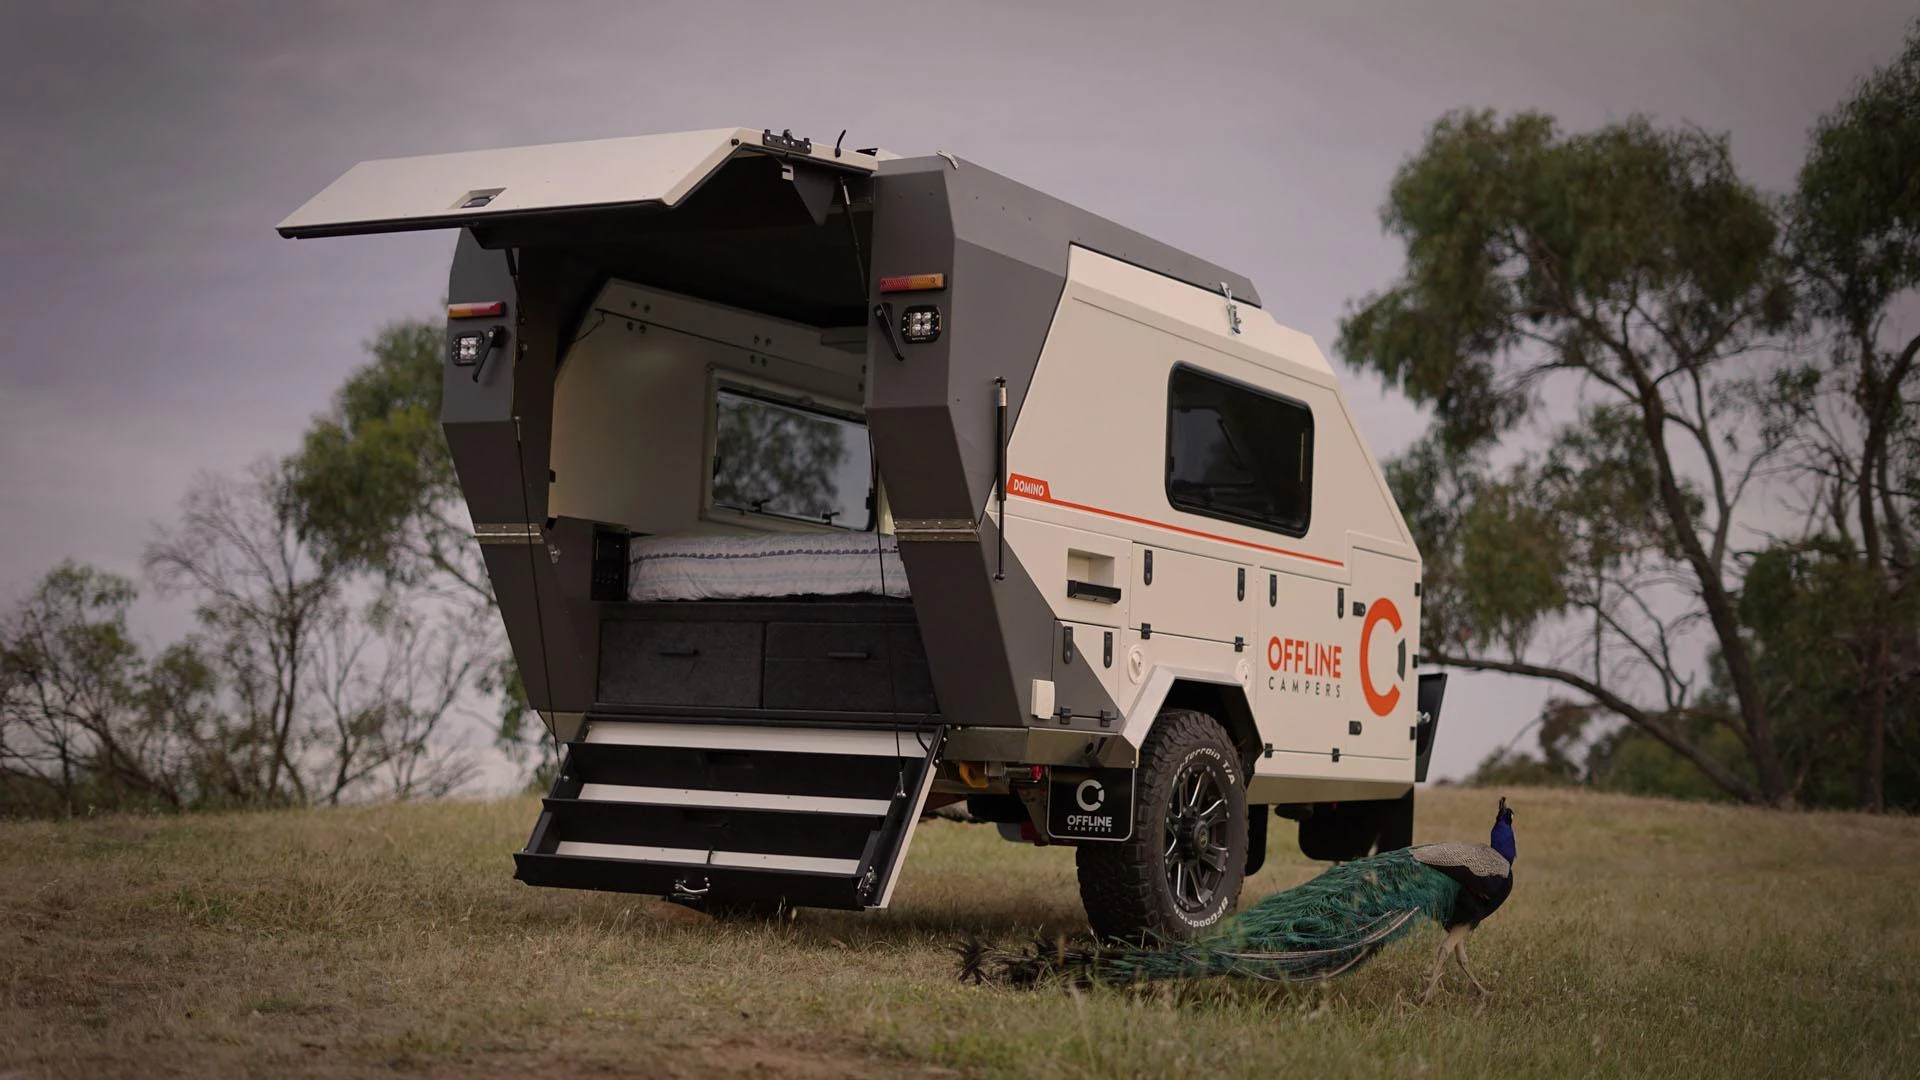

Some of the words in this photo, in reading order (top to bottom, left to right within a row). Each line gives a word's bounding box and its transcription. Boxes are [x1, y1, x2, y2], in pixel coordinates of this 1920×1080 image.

[1013, 479, 1045, 496] DOMINO
[1268, 636, 1342, 679] OFFLINE
[1268, 676, 1341, 698] CAMPERS
[1067, 814, 1112, 827] OFFLINE
